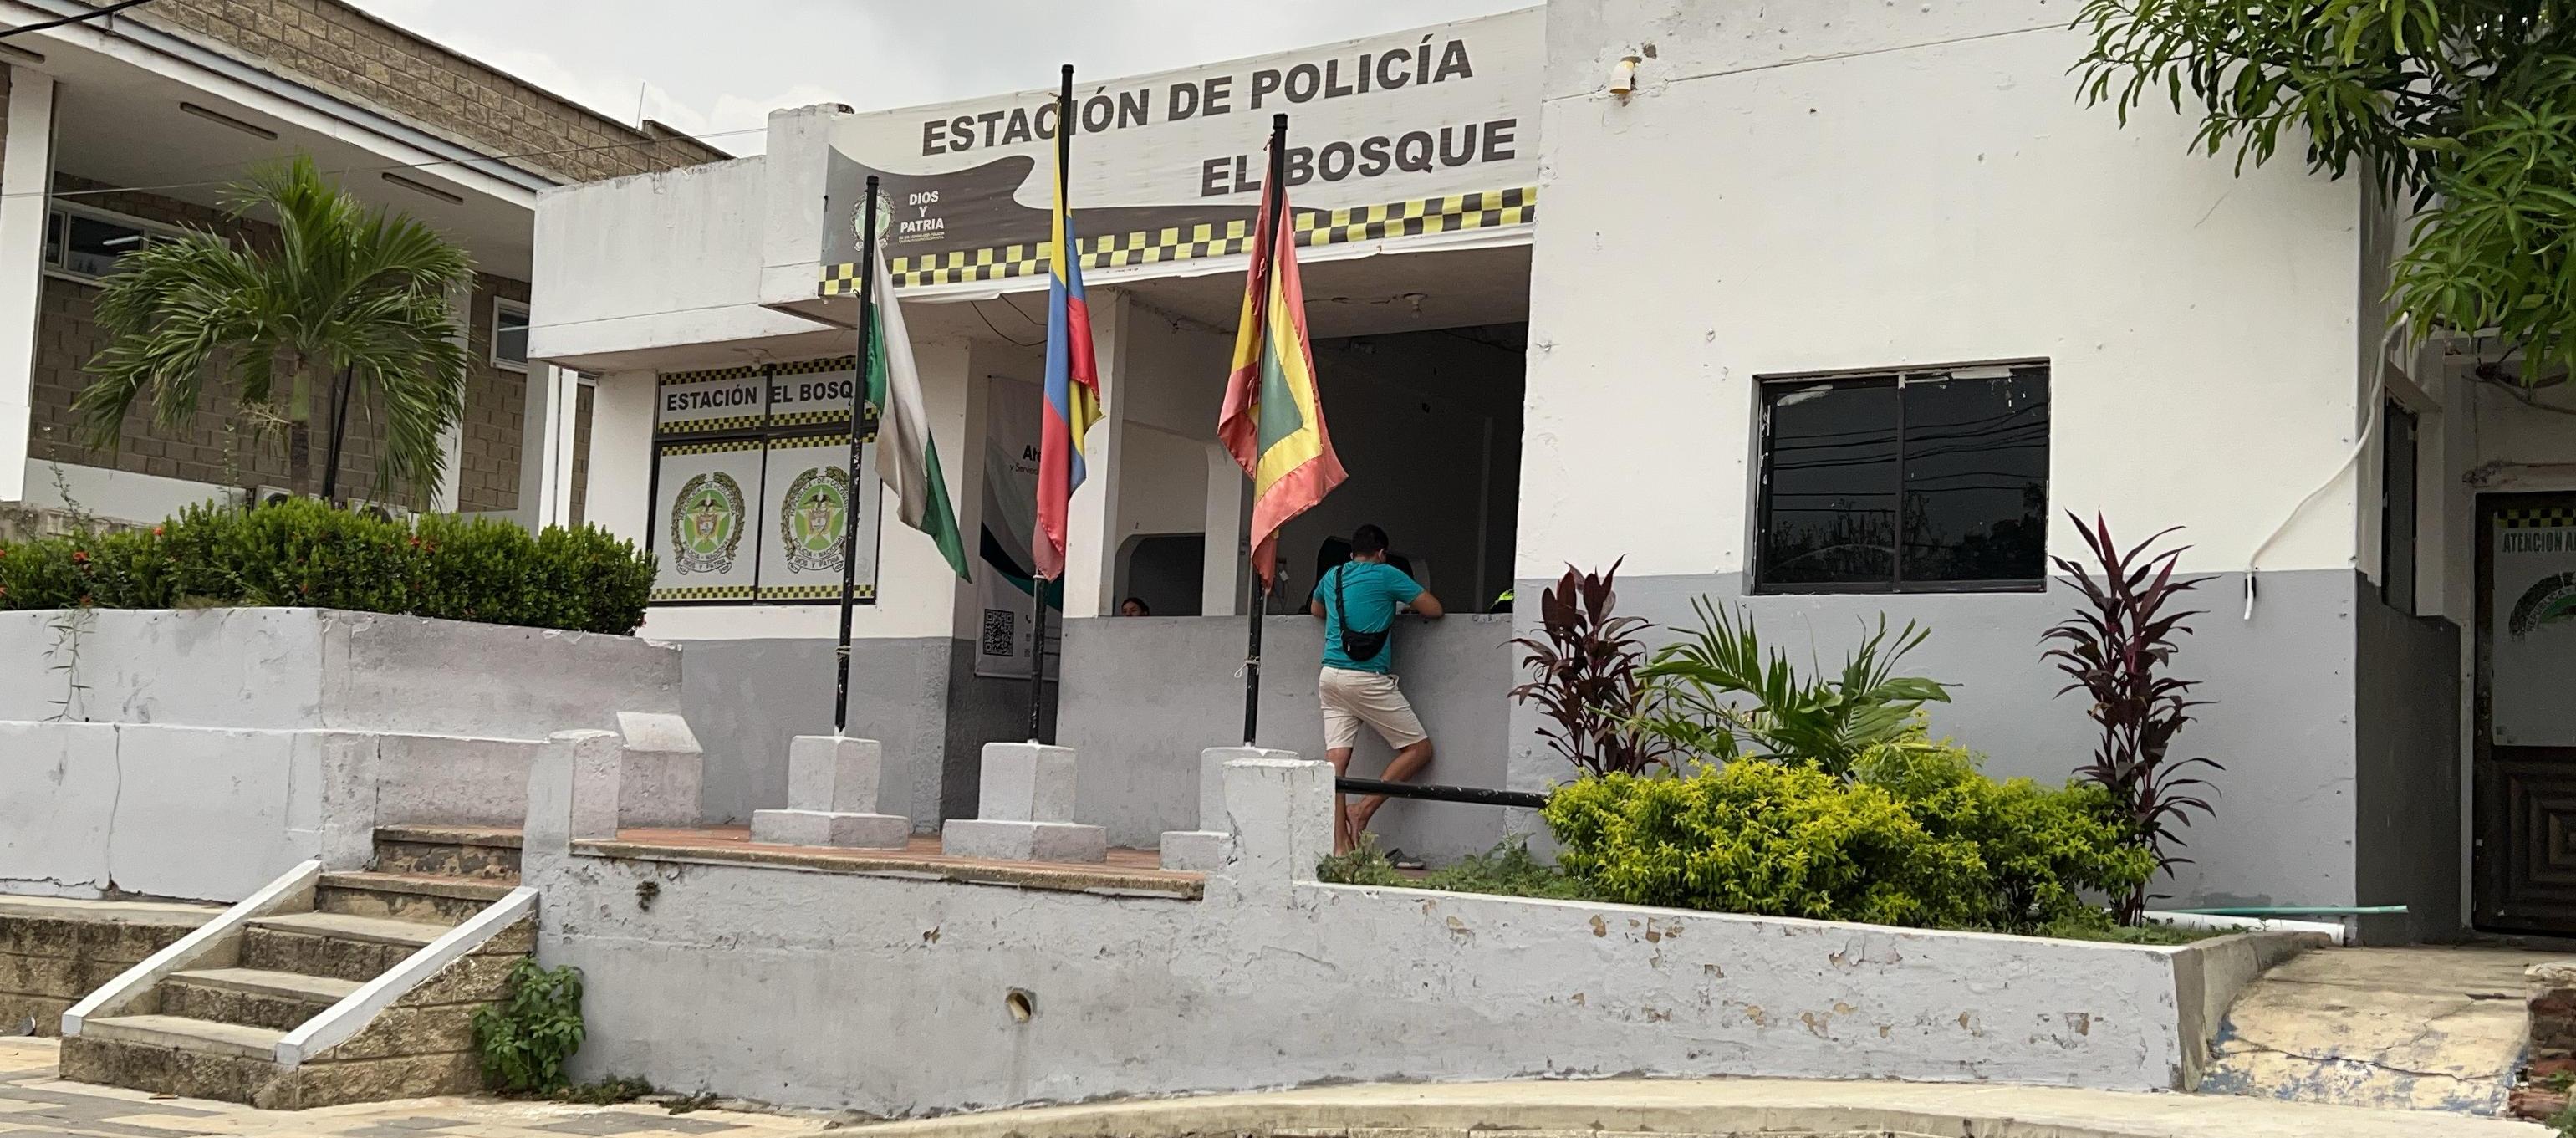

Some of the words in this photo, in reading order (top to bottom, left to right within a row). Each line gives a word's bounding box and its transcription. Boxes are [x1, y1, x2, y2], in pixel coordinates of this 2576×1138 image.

[922, 85, 1150, 156] ESTACIÓN
[1168, 75, 1233, 122] DE
[1250, 33, 1474, 110] POLICÍA
[1201, 154, 1262, 197] EL
[1284, 118, 1518, 186] BOSQUE
[909, 191, 940, 206] DIOS
[919, 206, 928, 217] Y
[900, 217, 945, 233] PATRIA
[666, 384, 757, 411] ESTACIÓN
[771, 385, 793, 403] EL
[799, 380, 854, 401] BOSQ
[2502, 530, 2562, 553] ATENCION
